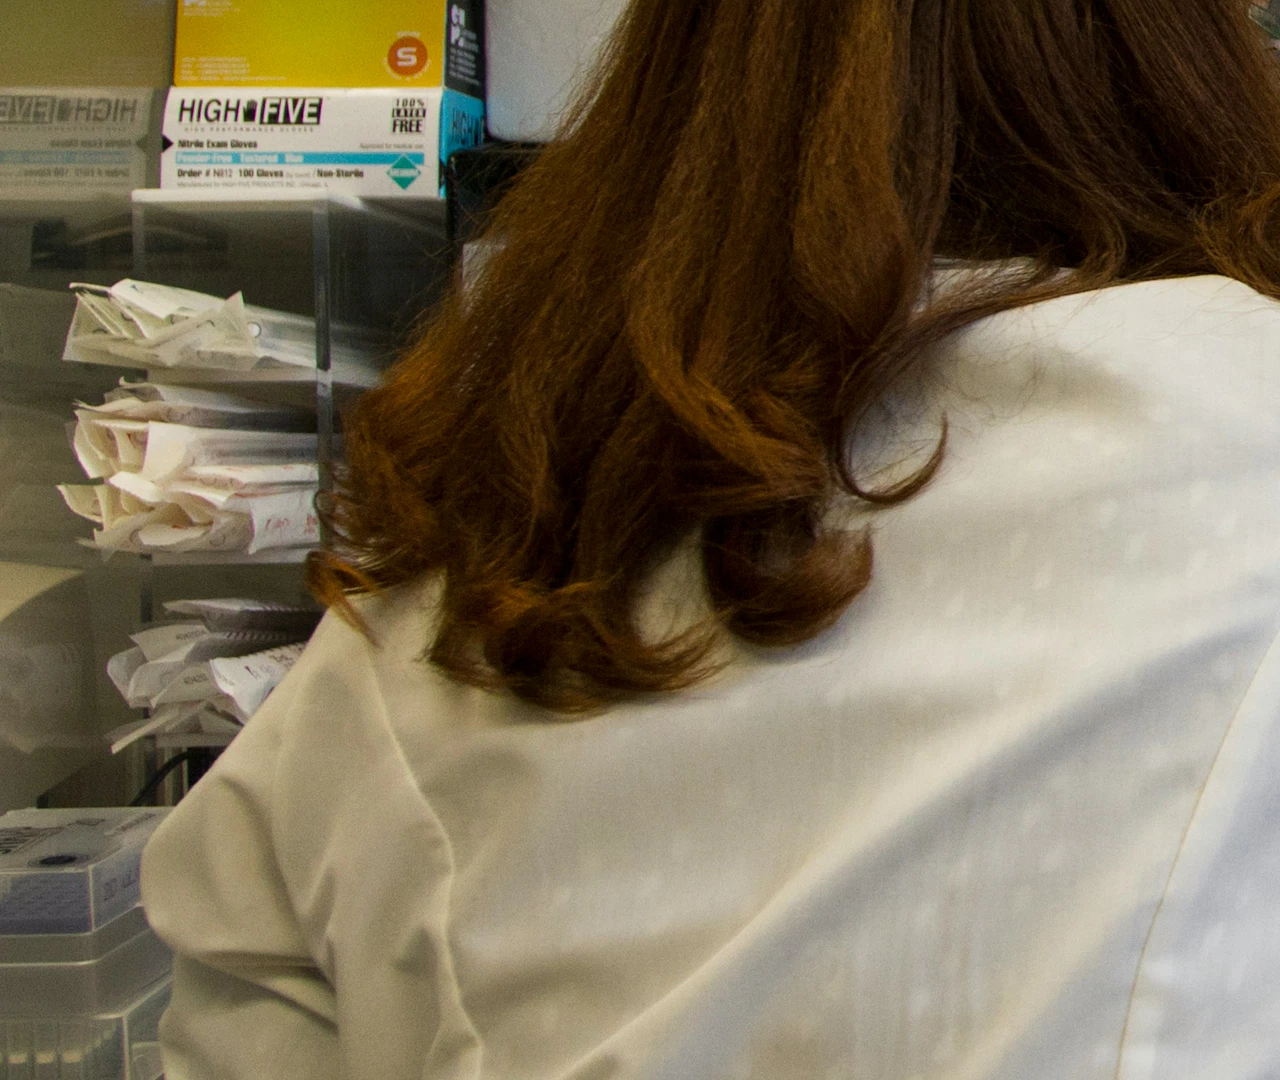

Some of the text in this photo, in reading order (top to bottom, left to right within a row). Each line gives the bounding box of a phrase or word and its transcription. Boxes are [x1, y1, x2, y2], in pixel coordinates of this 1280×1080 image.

[396, 46, 418, 67] S
[395, 98, 425, 107] 100%
[178, 98, 323, 125] HIGH FIVE
[392, 120, 423, 133] FREE
[178, 139, 258, 149] Nitrile Exam Gloves
[178, 168, 202, 178] Order
[238, 168, 254, 178] 100
[256, 168, 284, 178] Gloves
[317, 168, 364, 178] Non-Sterile
